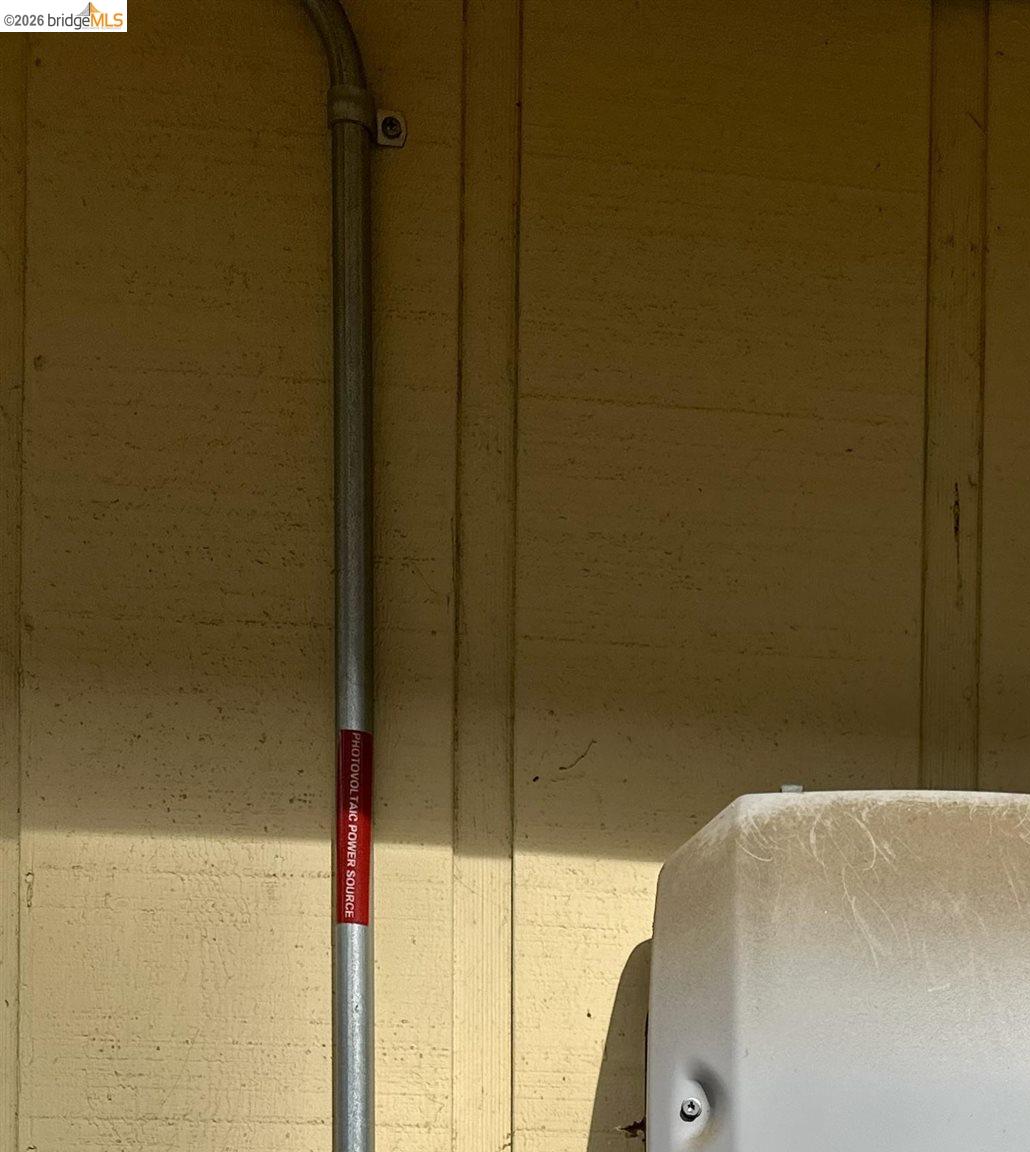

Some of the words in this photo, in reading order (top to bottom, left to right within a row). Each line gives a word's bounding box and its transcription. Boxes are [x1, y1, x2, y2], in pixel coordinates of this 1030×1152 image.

[348, 732, 361, 821] PHOTOVOLTAIC
[347, 824, 358, 867] POWER
[345, 870, 356, 918] SOURCE
